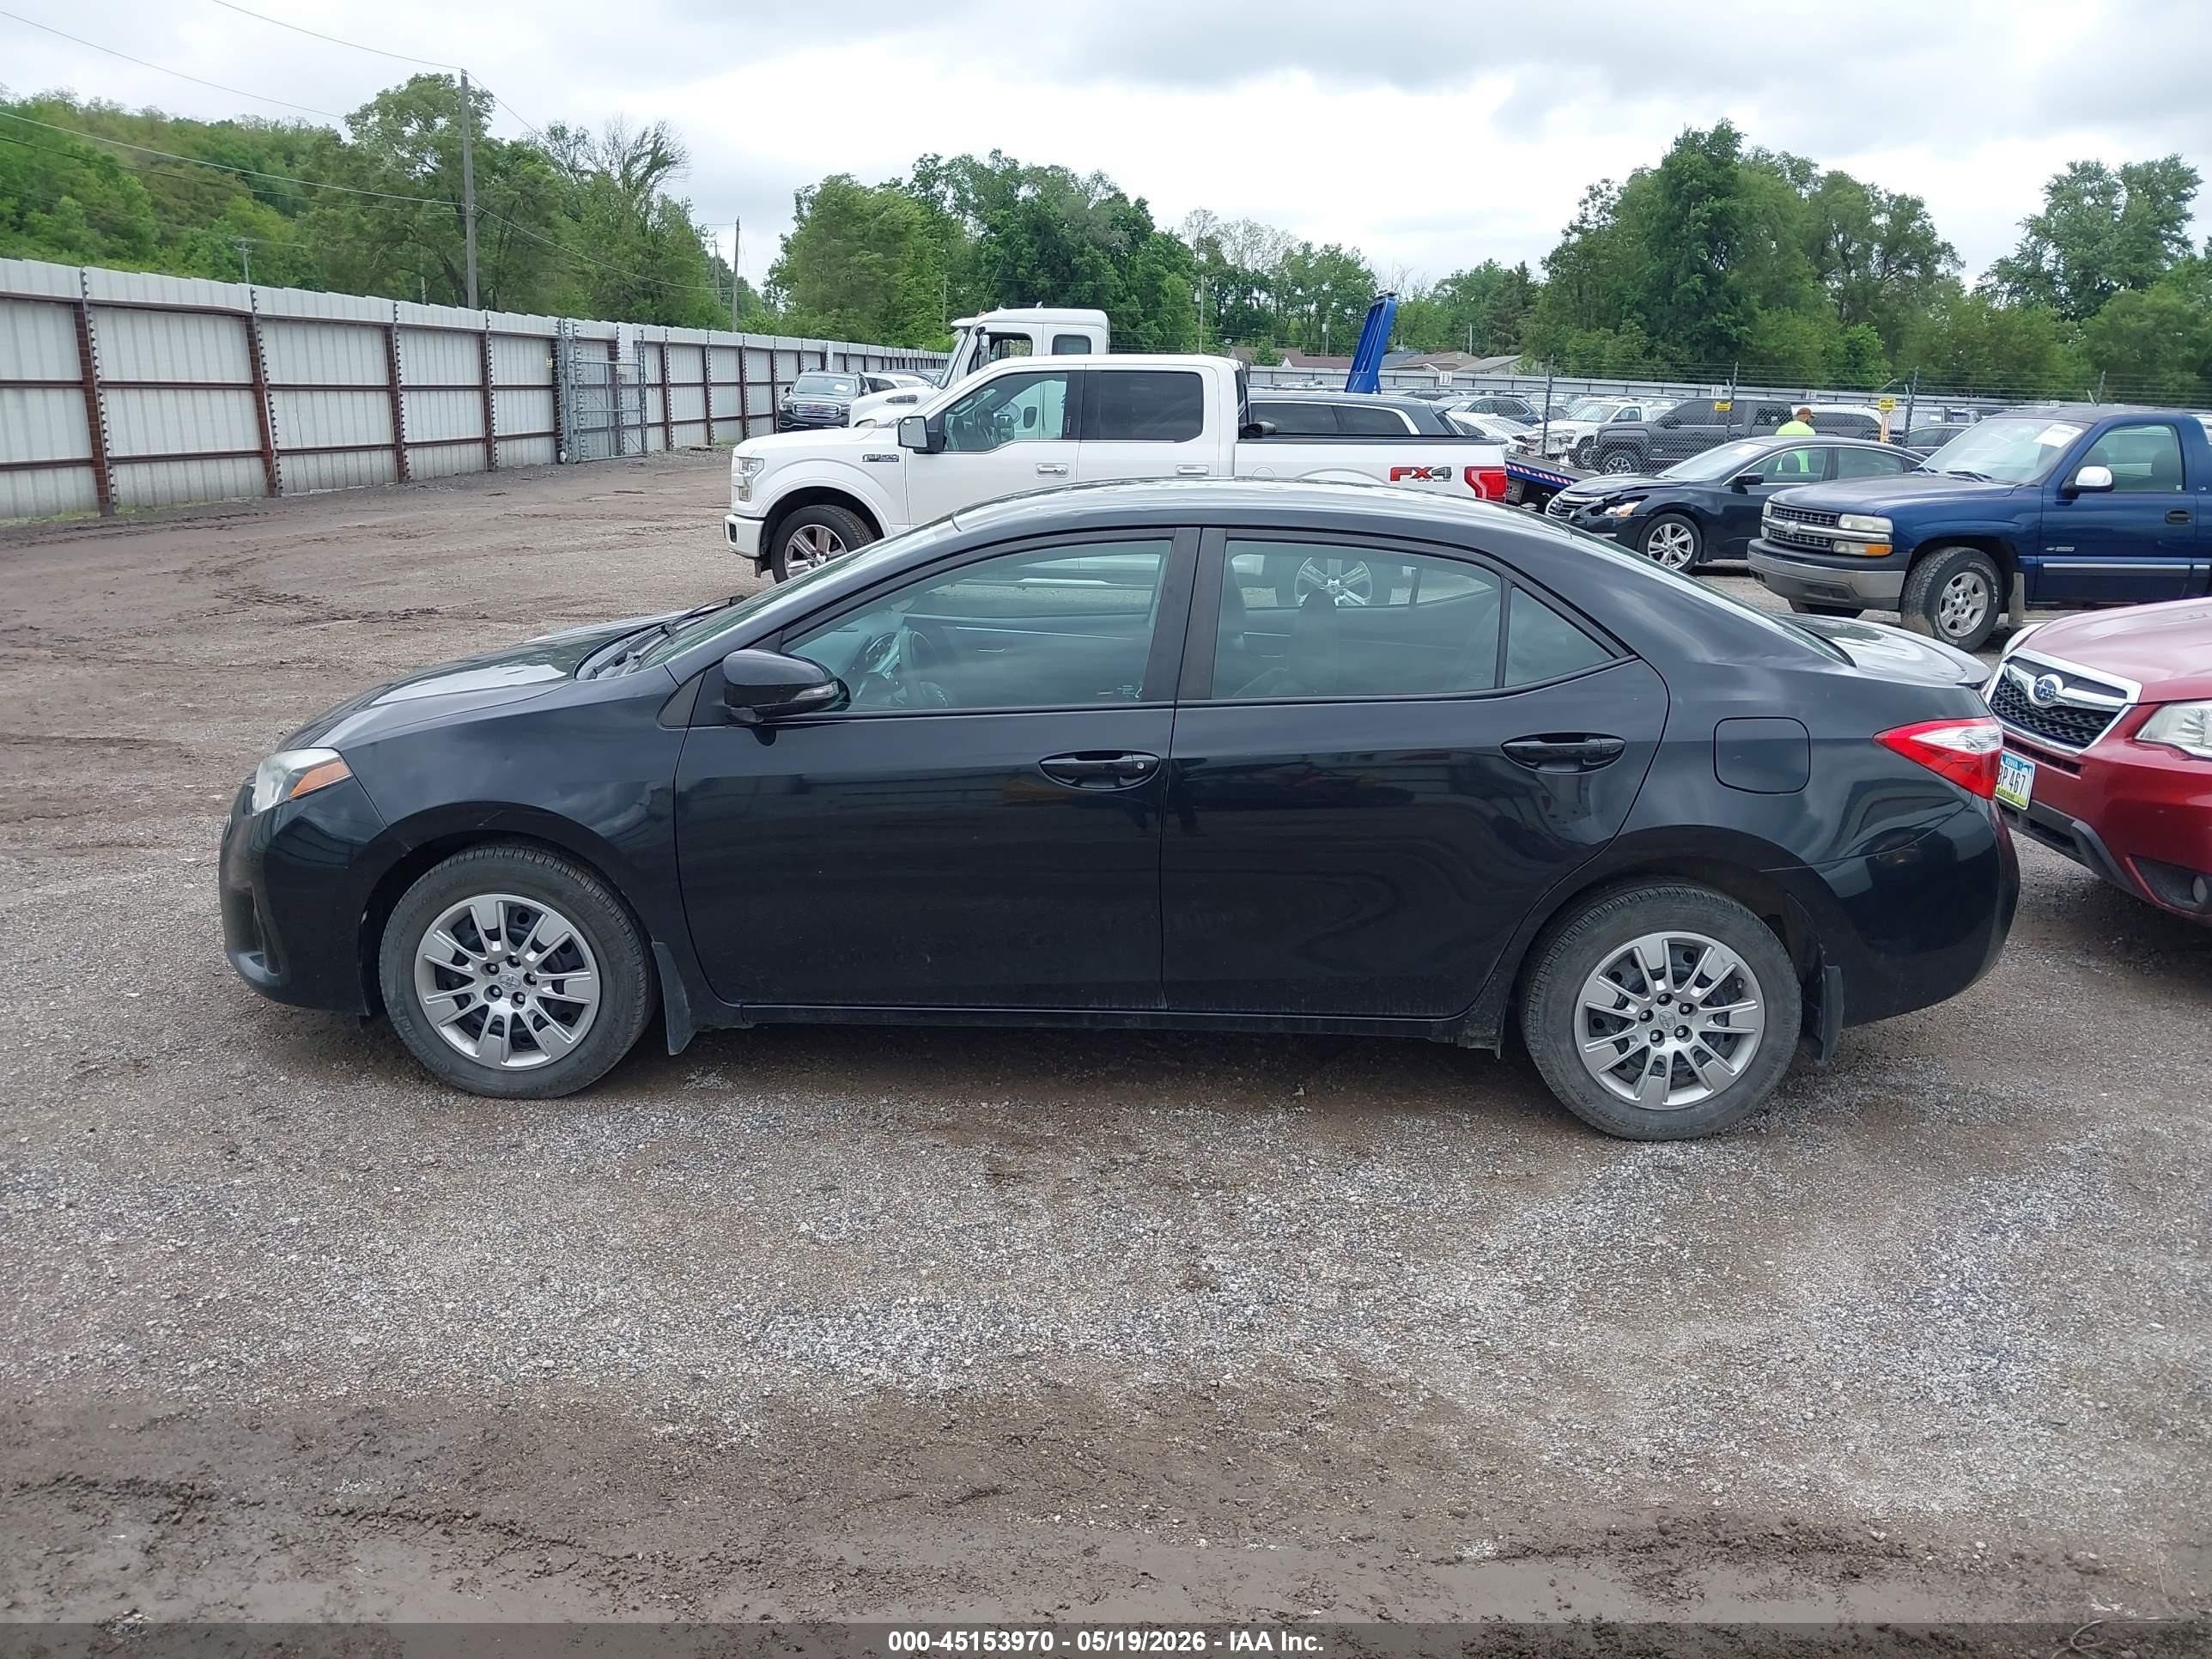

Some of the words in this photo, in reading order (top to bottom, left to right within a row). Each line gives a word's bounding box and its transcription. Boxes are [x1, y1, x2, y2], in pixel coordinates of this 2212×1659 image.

[1390, 466, 1452, 482] FX4
[2005, 756, 2019, 770] IOWA
[2009, 770, 2026, 795] 467
